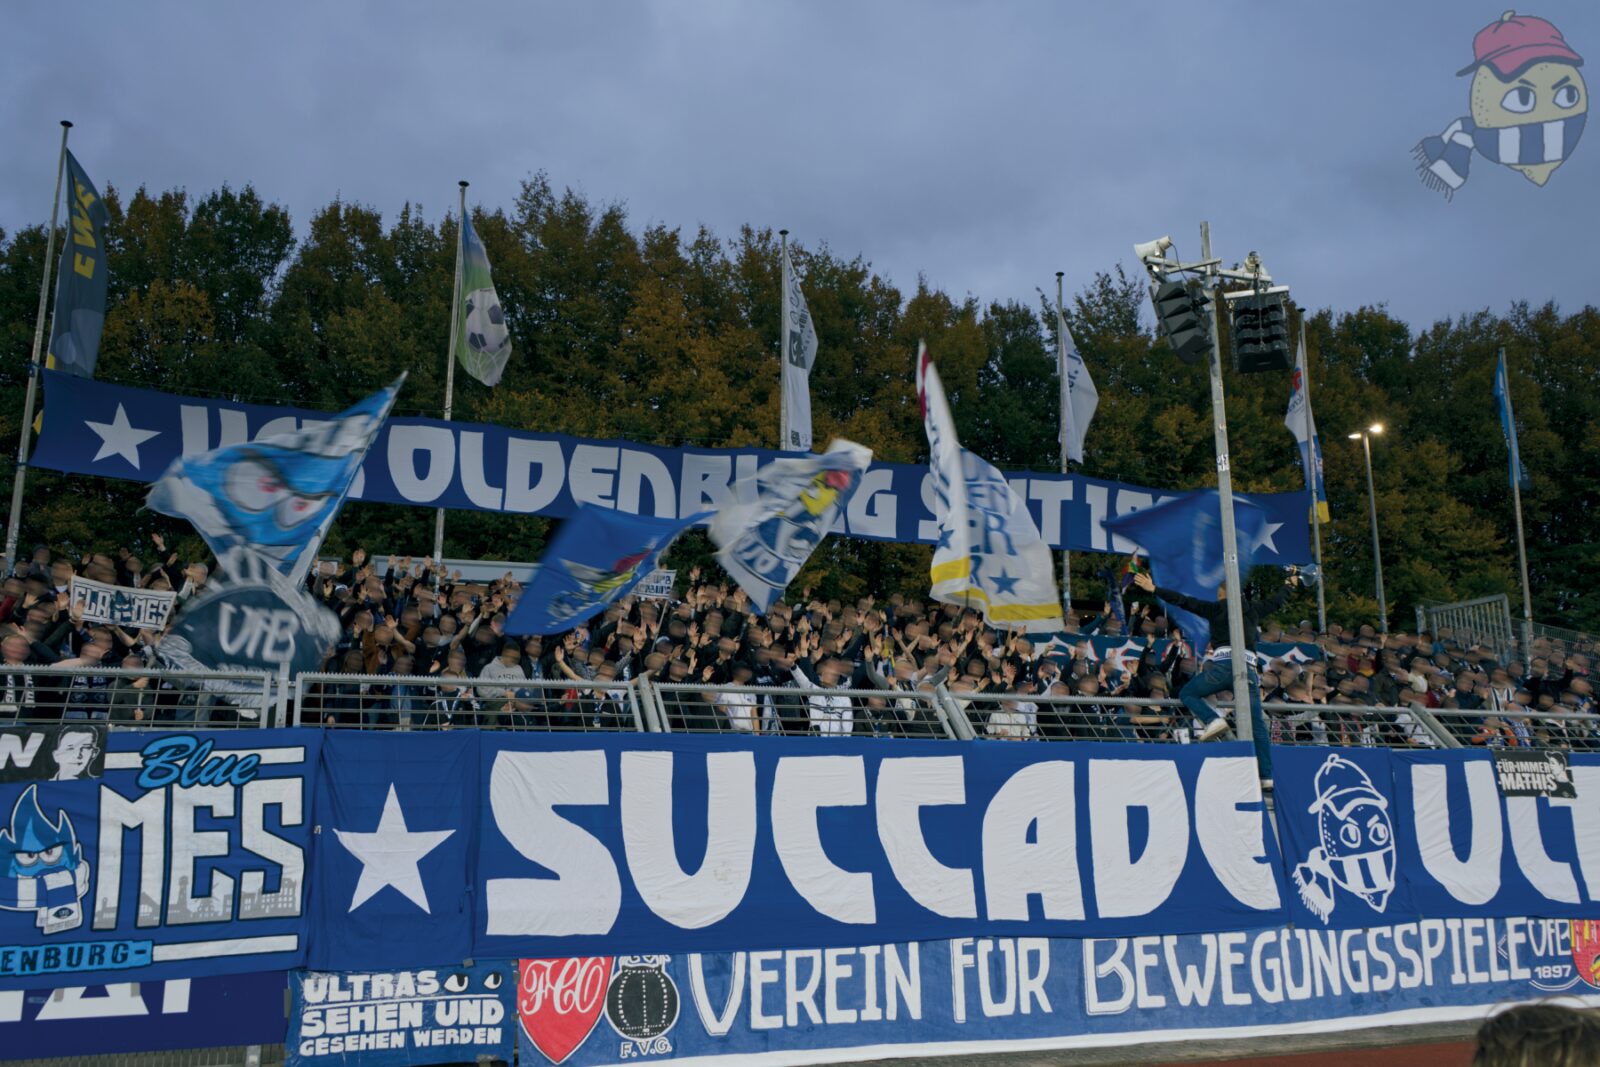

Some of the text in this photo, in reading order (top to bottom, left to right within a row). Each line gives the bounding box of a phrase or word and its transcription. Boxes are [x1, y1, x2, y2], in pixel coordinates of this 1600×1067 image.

[388, 424, 898, 539] OLDENBG
[136, 735, 262, 790] Blue
[486, 750, 1282, 937] SUCCADE
[303, 970, 440, 1004] ULTRAS
[688, 940, 922, 1037] VEREIN
[1534, 964, 1572, 979] 1897
[301, 998, 505, 1038] SEHEN UND
[300, 1027, 502, 1057] GESEHEN WERDEN
